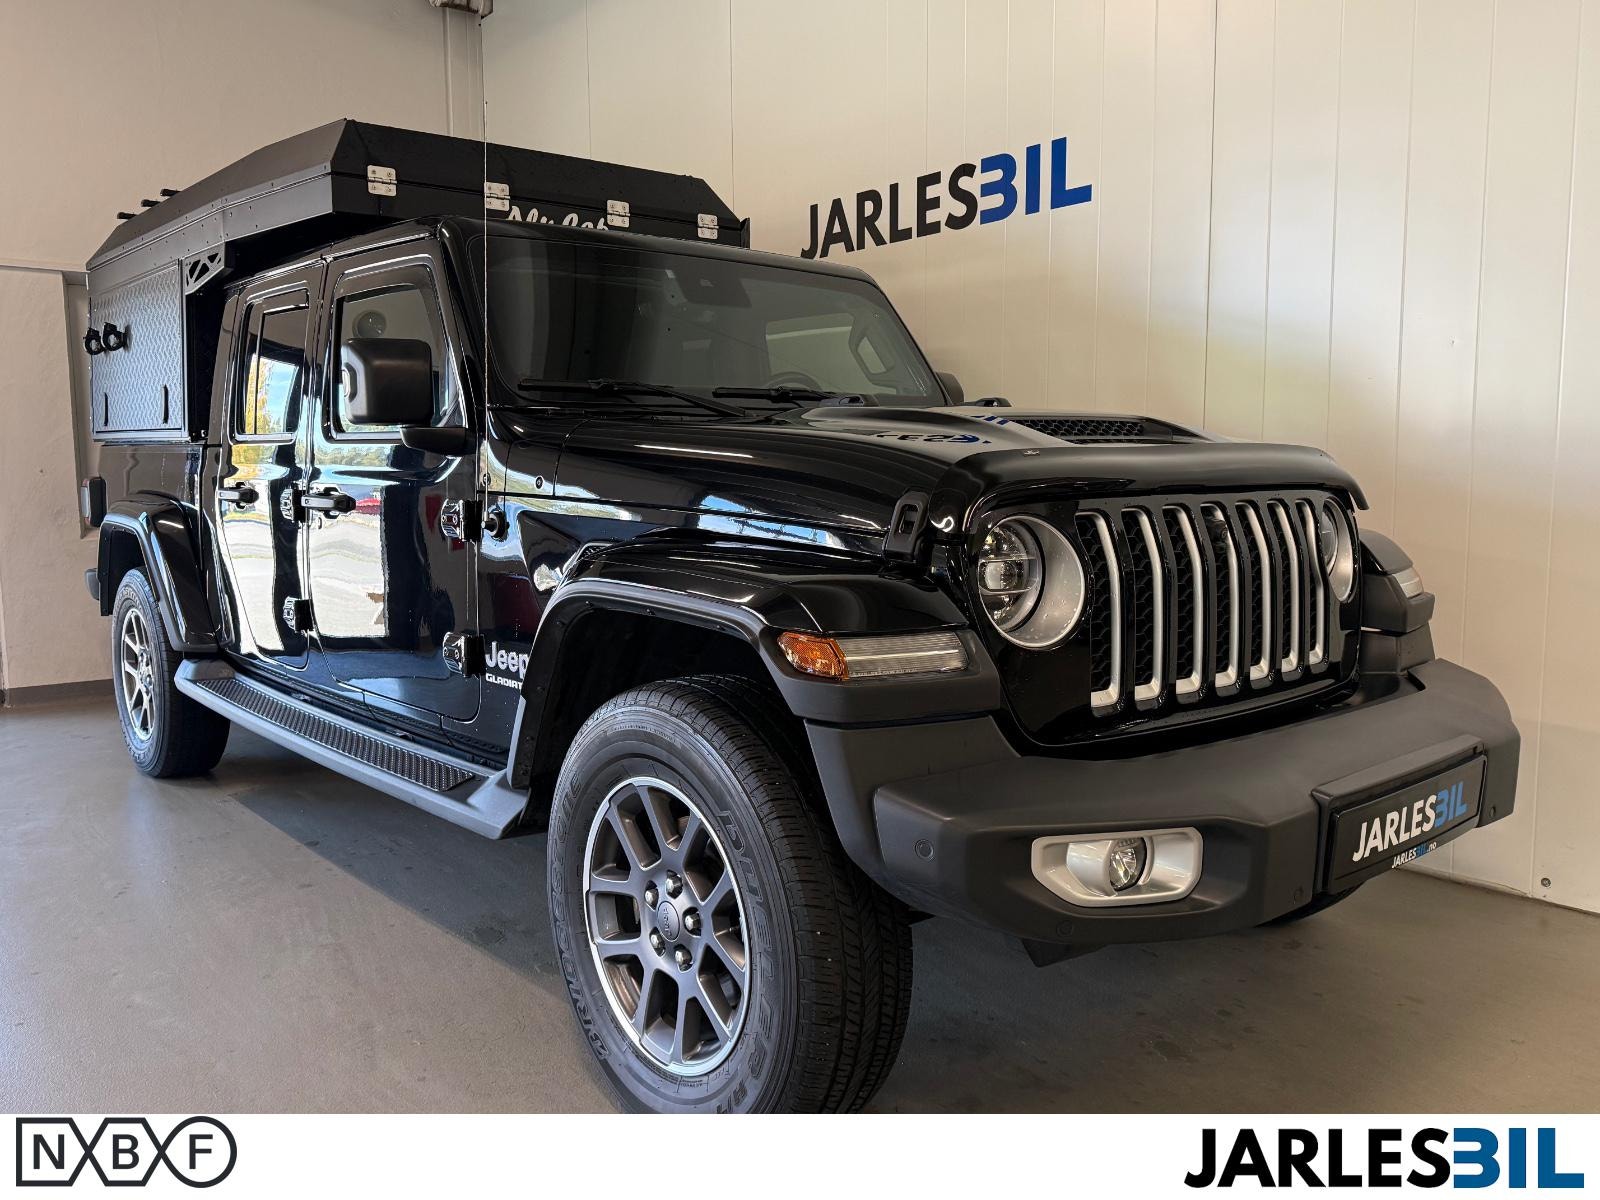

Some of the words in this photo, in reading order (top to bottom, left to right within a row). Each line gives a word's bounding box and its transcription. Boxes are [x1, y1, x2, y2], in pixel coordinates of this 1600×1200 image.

[800, 136, 1093, 260] JARLESBIL
[485, 640, 529, 680] Jeep
[485, 672, 522, 690] GLADIAT
[1352, 780, 1468, 862] JARLESBIL
